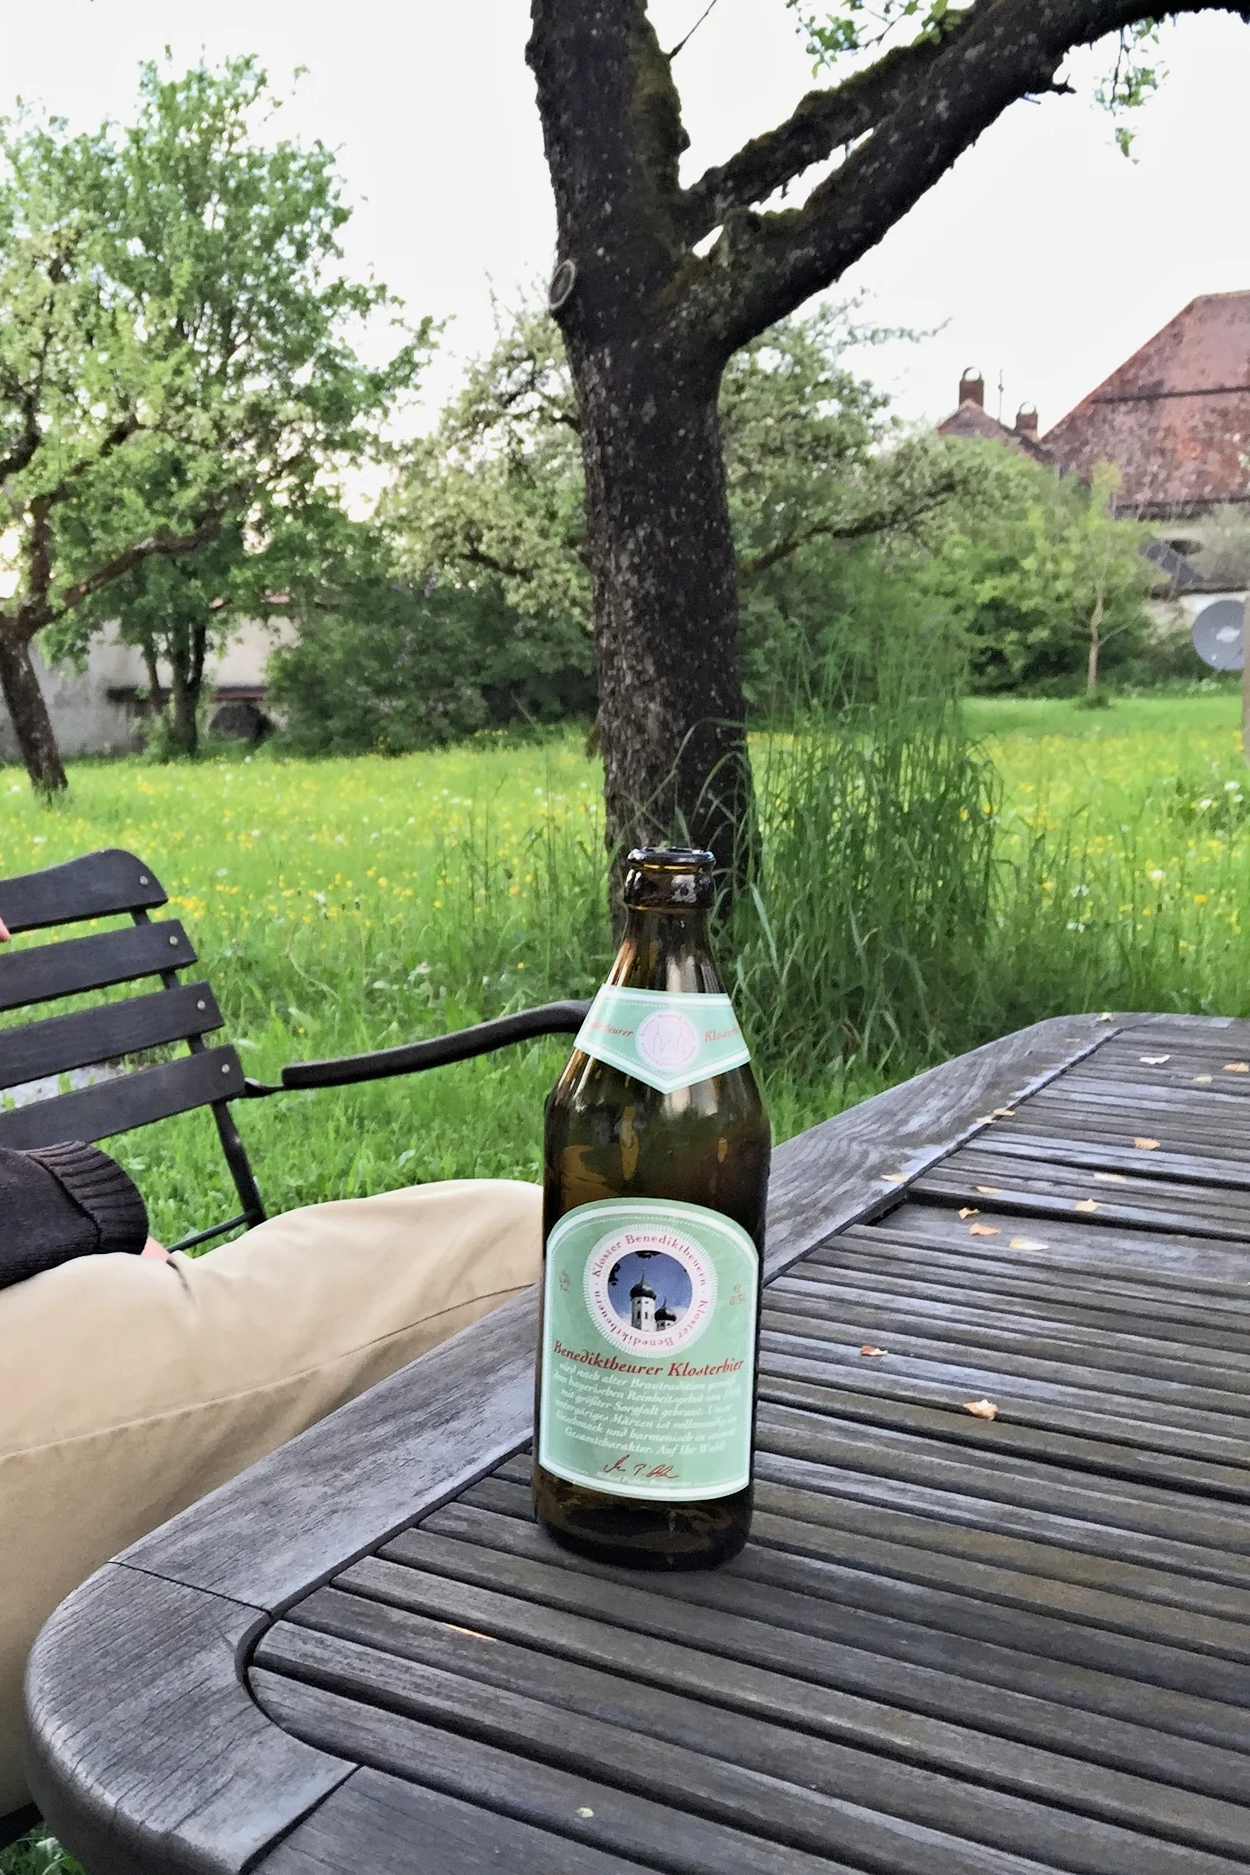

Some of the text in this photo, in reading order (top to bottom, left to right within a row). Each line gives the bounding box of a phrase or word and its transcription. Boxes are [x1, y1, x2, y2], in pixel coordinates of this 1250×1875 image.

[591, 1241, 622, 1278] Kloster
[624, 1234, 707, 1286] Benediktbeuern
[594, 1289, 709, 1348] Kloster Benediktbeuern
[553, 1340, 745, 1377] Benediktbeurer Klosterbier
[601, 1374, 628, 1386] alter
[613, 1401, 660, 1417] Sorgfalt
[610, 1413, 654, 1429] Märzen
[606, 1427, 628, 1438] und
[656, 1444, 679, 1457] Auf
